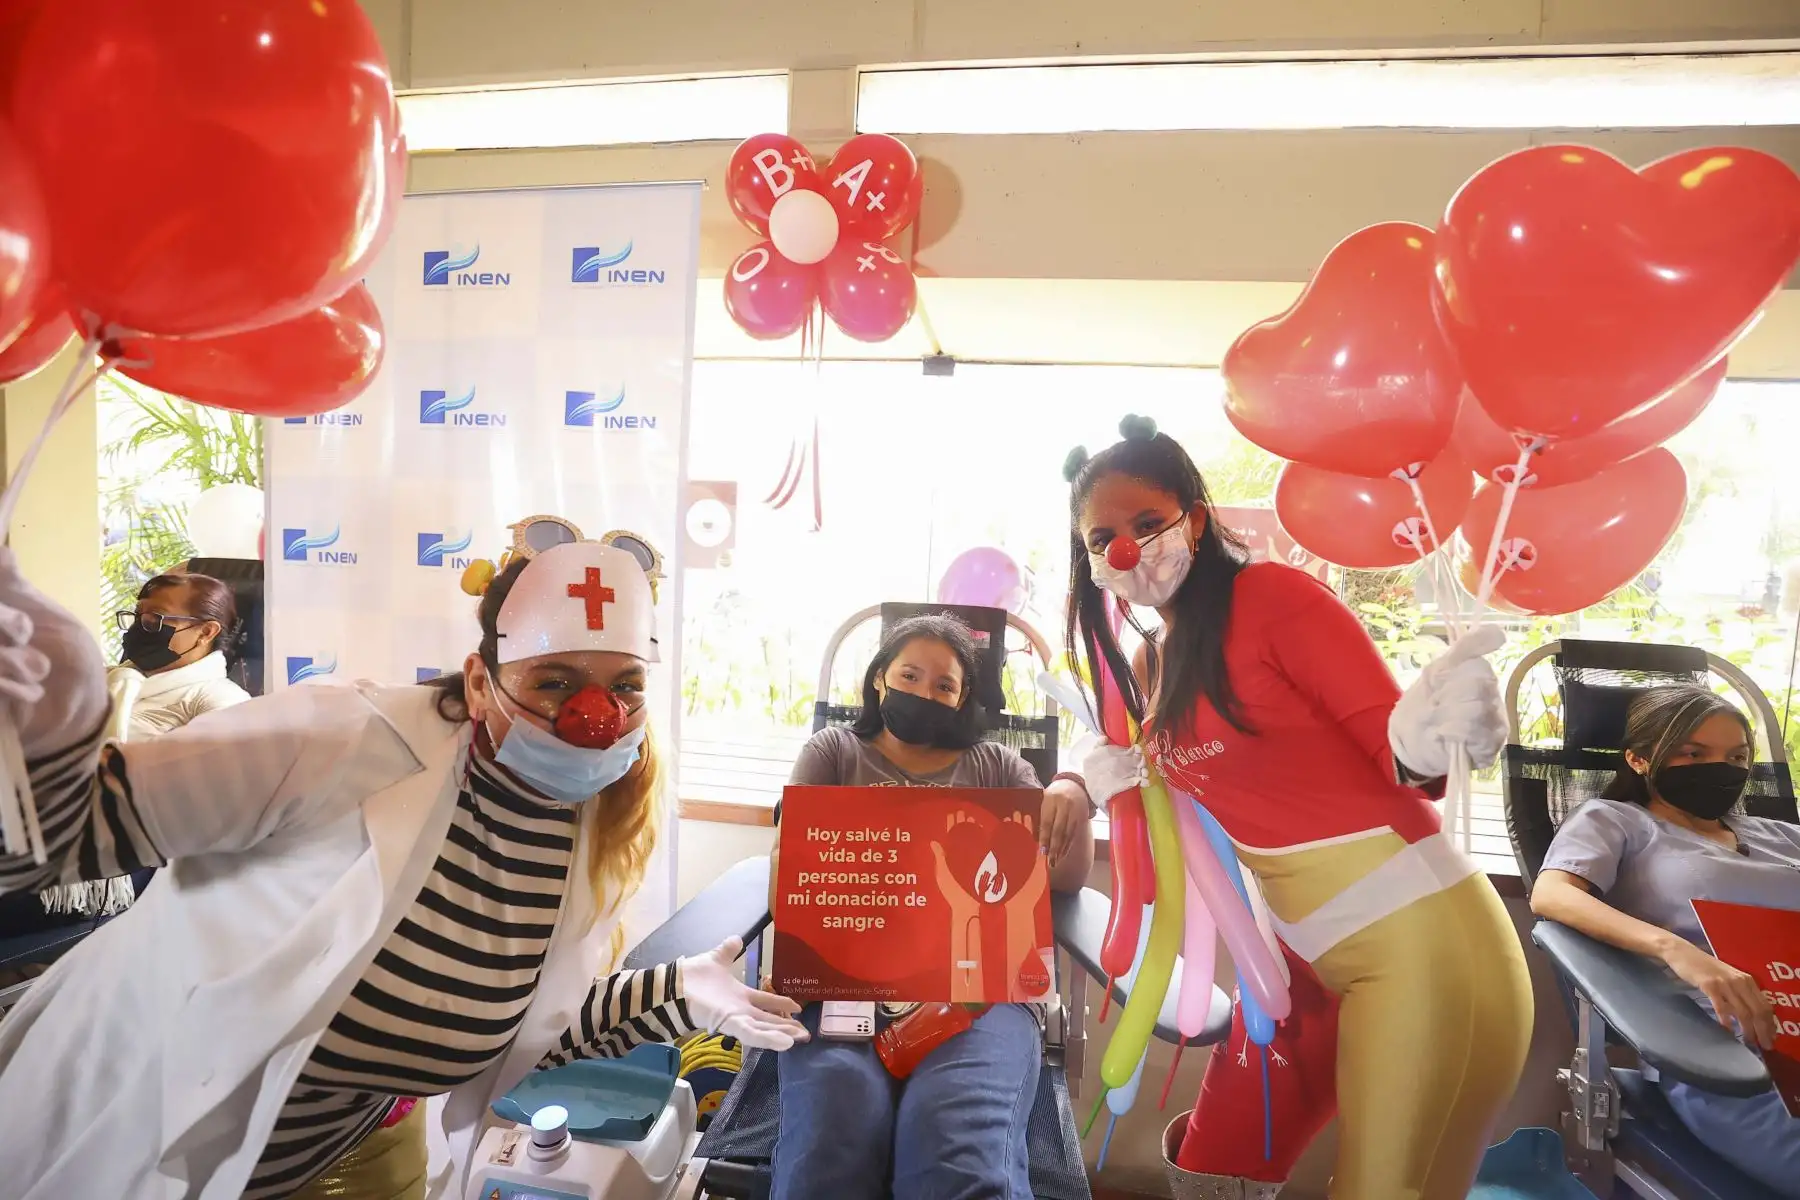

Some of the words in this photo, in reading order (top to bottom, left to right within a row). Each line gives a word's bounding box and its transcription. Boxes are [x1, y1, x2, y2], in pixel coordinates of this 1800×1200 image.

[806, 827, 841, 845] Hoy
[845, 827, 891, 842] salvé
[896, 828, 911, 842] la
[819, 847, 856, 863] vida
[860, 848, 883, 863] de
[887, 849, 898, 864] 3
[798, 871, 880, 887] personas
[884, 873, 917, 885] con
[787, 889, 811, 906] mi
[815, 890, 899, 907] donación
[904, 891, 927, 907] de
[822, 915, 885, 932] sangre
